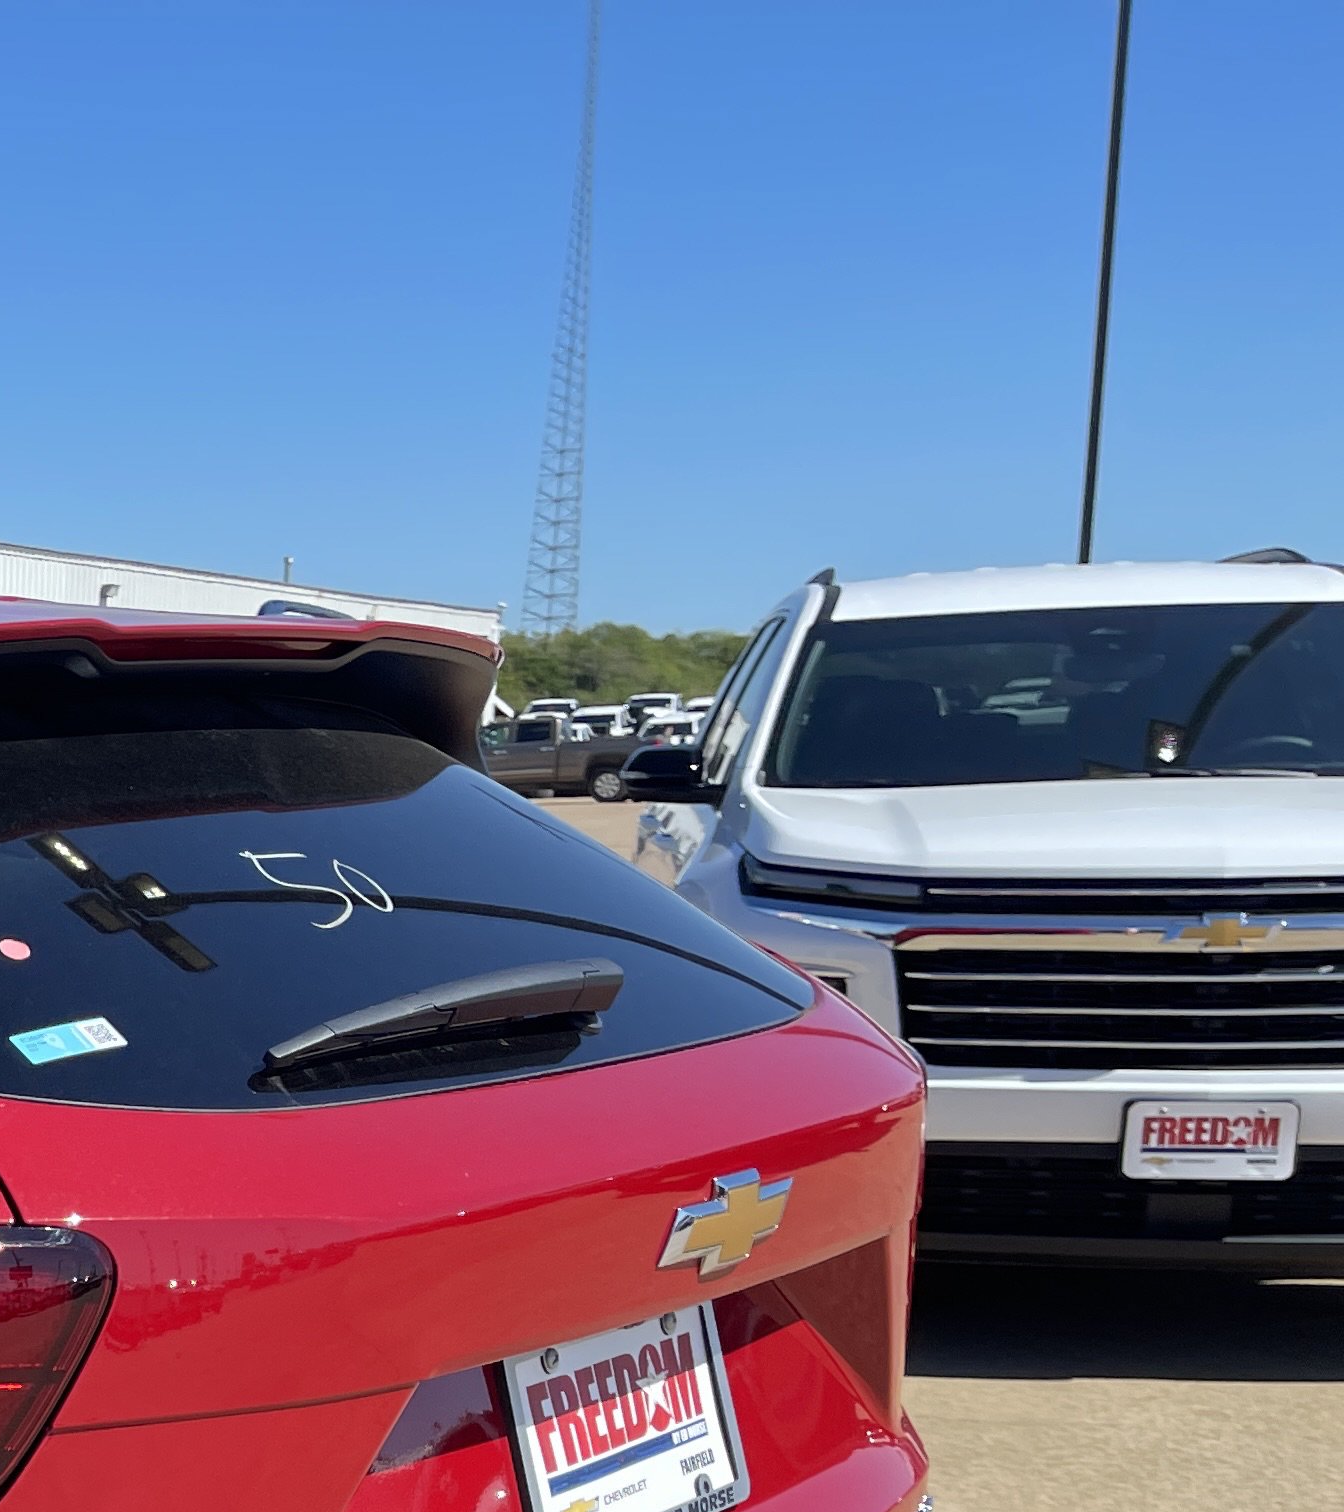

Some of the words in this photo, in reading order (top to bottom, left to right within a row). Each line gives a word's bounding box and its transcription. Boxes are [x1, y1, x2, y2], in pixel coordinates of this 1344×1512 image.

[239, 849, 394, 930] 50
[1142, 1117, 1281, 1147] FREEDOM
[526, 1332, 704, 1474] FREEDOM
[680, 1448, 715, 1476] FAIRFIELD
[603, 1479, 647, 1505] CHEVROLET
